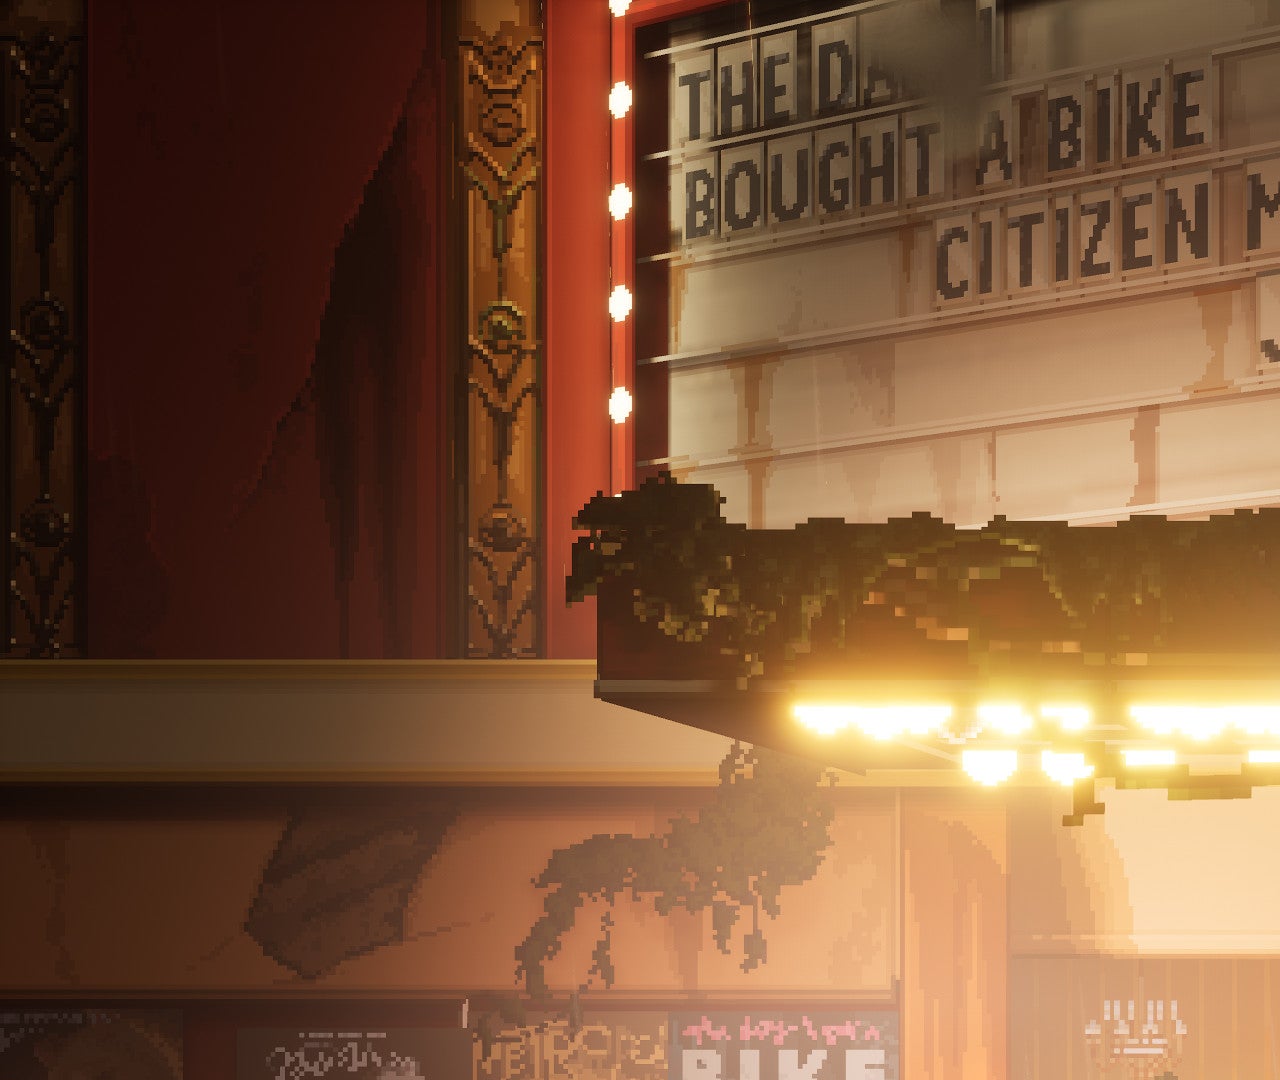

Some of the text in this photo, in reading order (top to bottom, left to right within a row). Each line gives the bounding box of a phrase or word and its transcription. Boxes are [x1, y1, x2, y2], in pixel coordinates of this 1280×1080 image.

[678, 50, 791, 141] THE
[685, 68, 1205, 240] BOUGHT A BIKE
[935, 183, 1209, 300] CITIZEN
